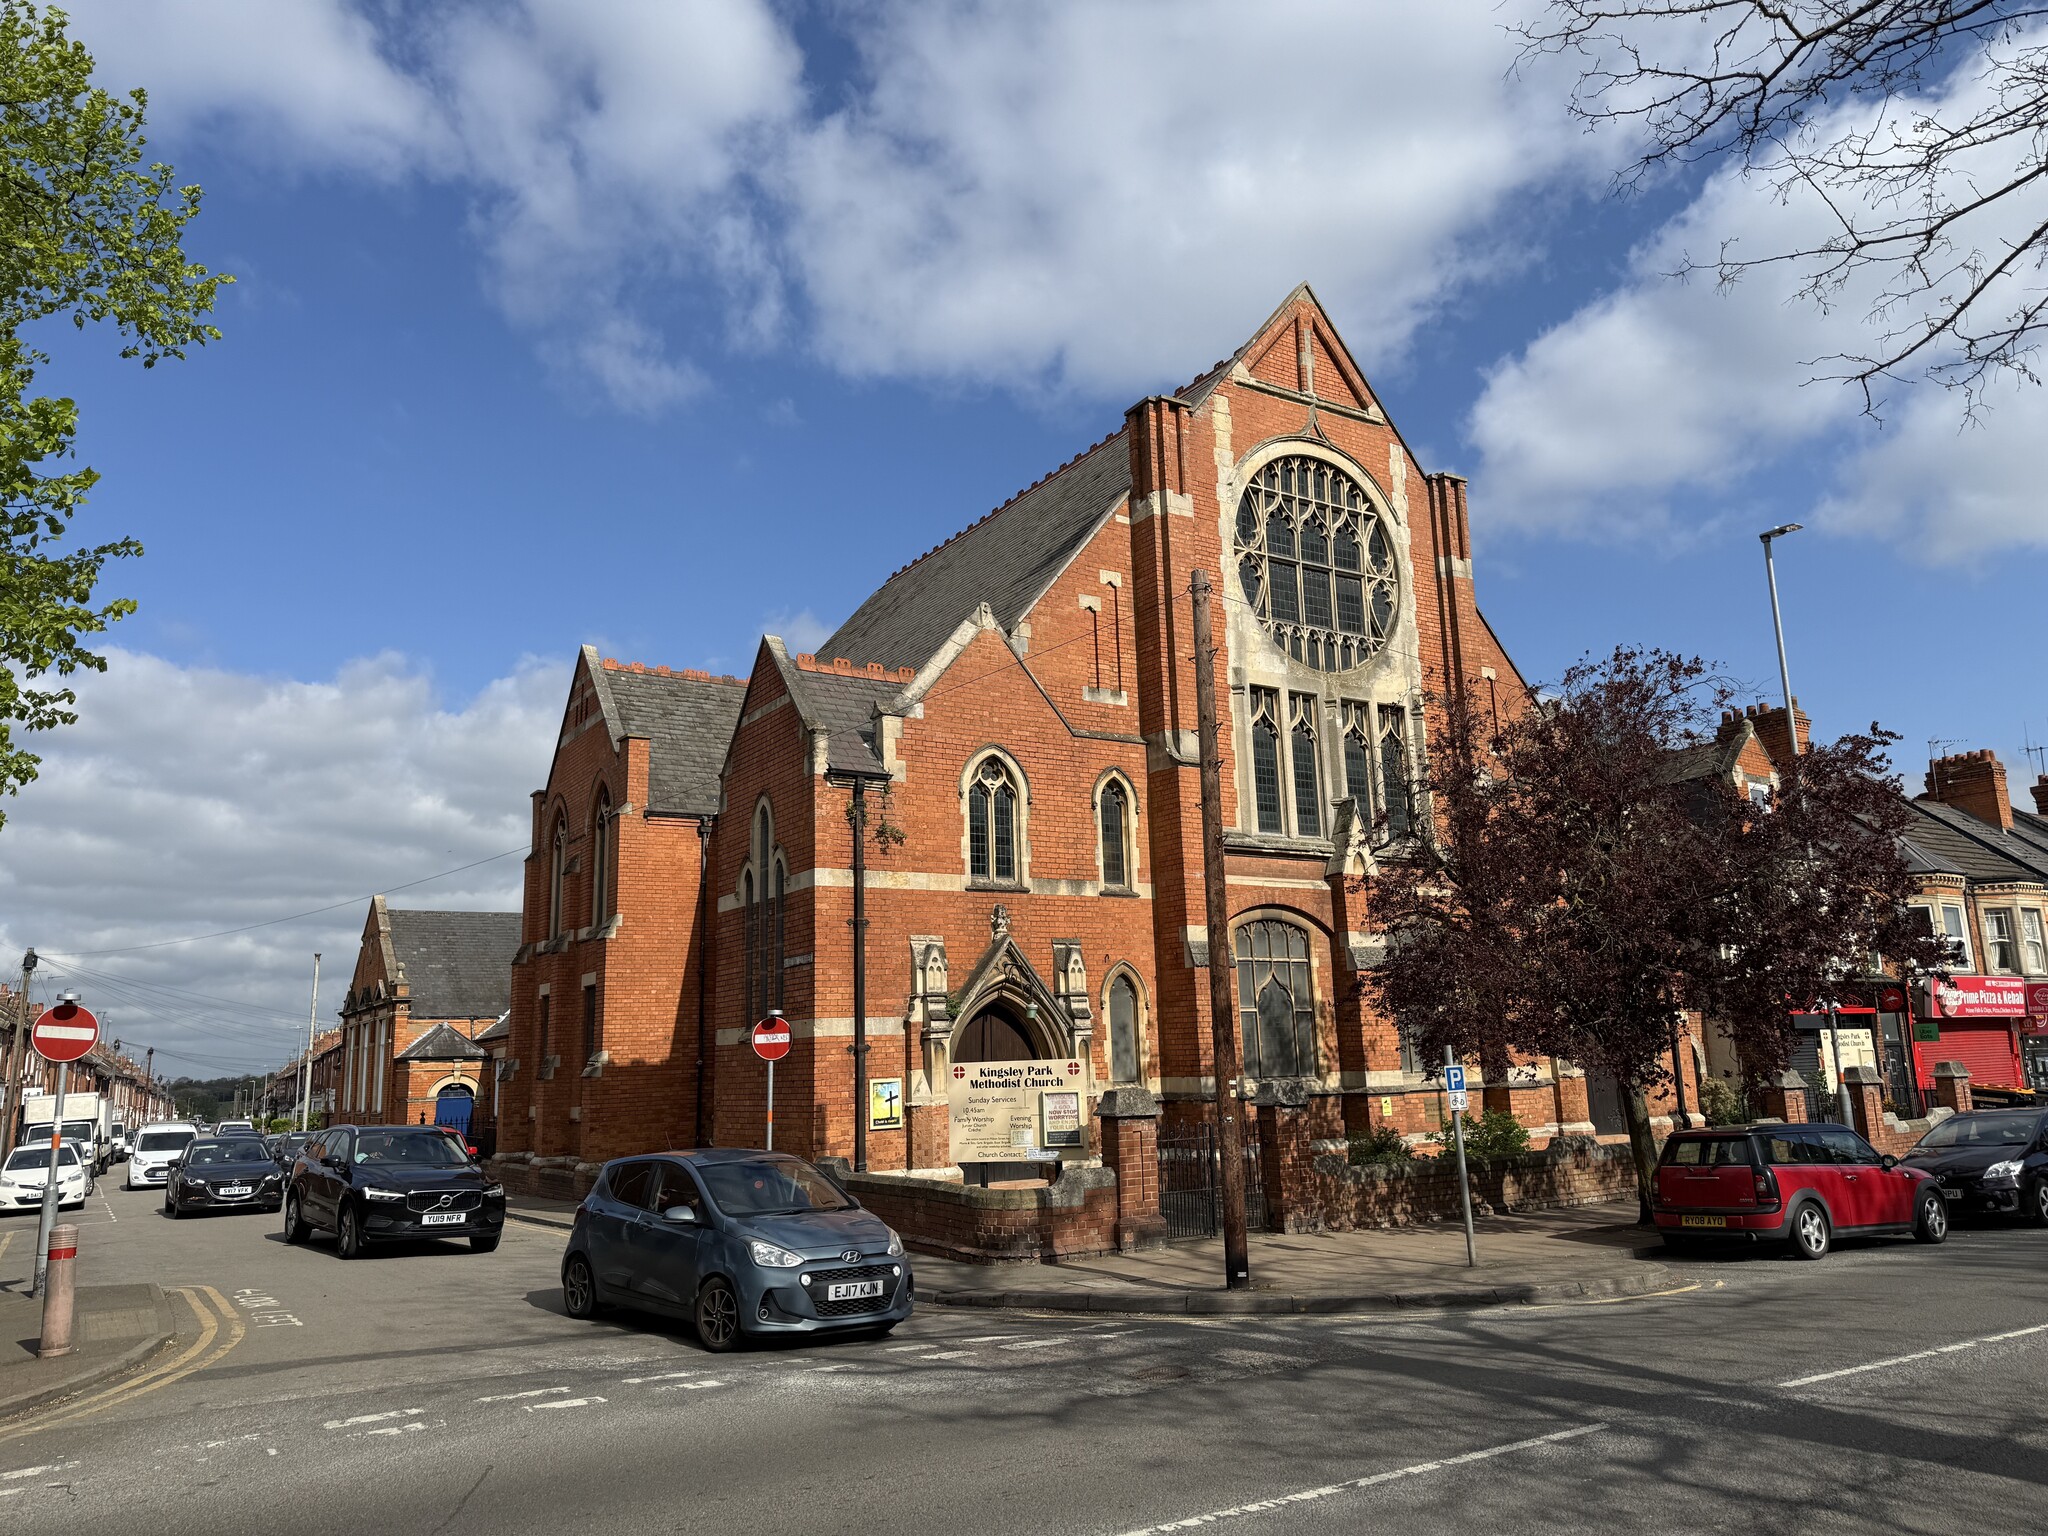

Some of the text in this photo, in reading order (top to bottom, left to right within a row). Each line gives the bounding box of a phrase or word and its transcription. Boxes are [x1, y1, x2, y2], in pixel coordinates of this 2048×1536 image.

[1960, 990, 1979, 1004] Prime
[1980, 990, 1997, 1004] Pizza
[1997, 992, 2002, 1004] &
[2003, 990, 2024, 1004] Kebab
[980, 1066, 1053, 1079] Kingsley Park
[1449, 1069, 1461, 1089] P
[970, 1077, 1063, 1089] Methodist Church
[954, 1116, 971, 1124] Family
[428, 1214, 462, 1223] YU19 NFR
[1685, 1216, 1723, 1225] RY08 AYO
[834, 1282, 878, 1298] EJ17 KJN
[250, 1309, 303, 1328] LEFT
